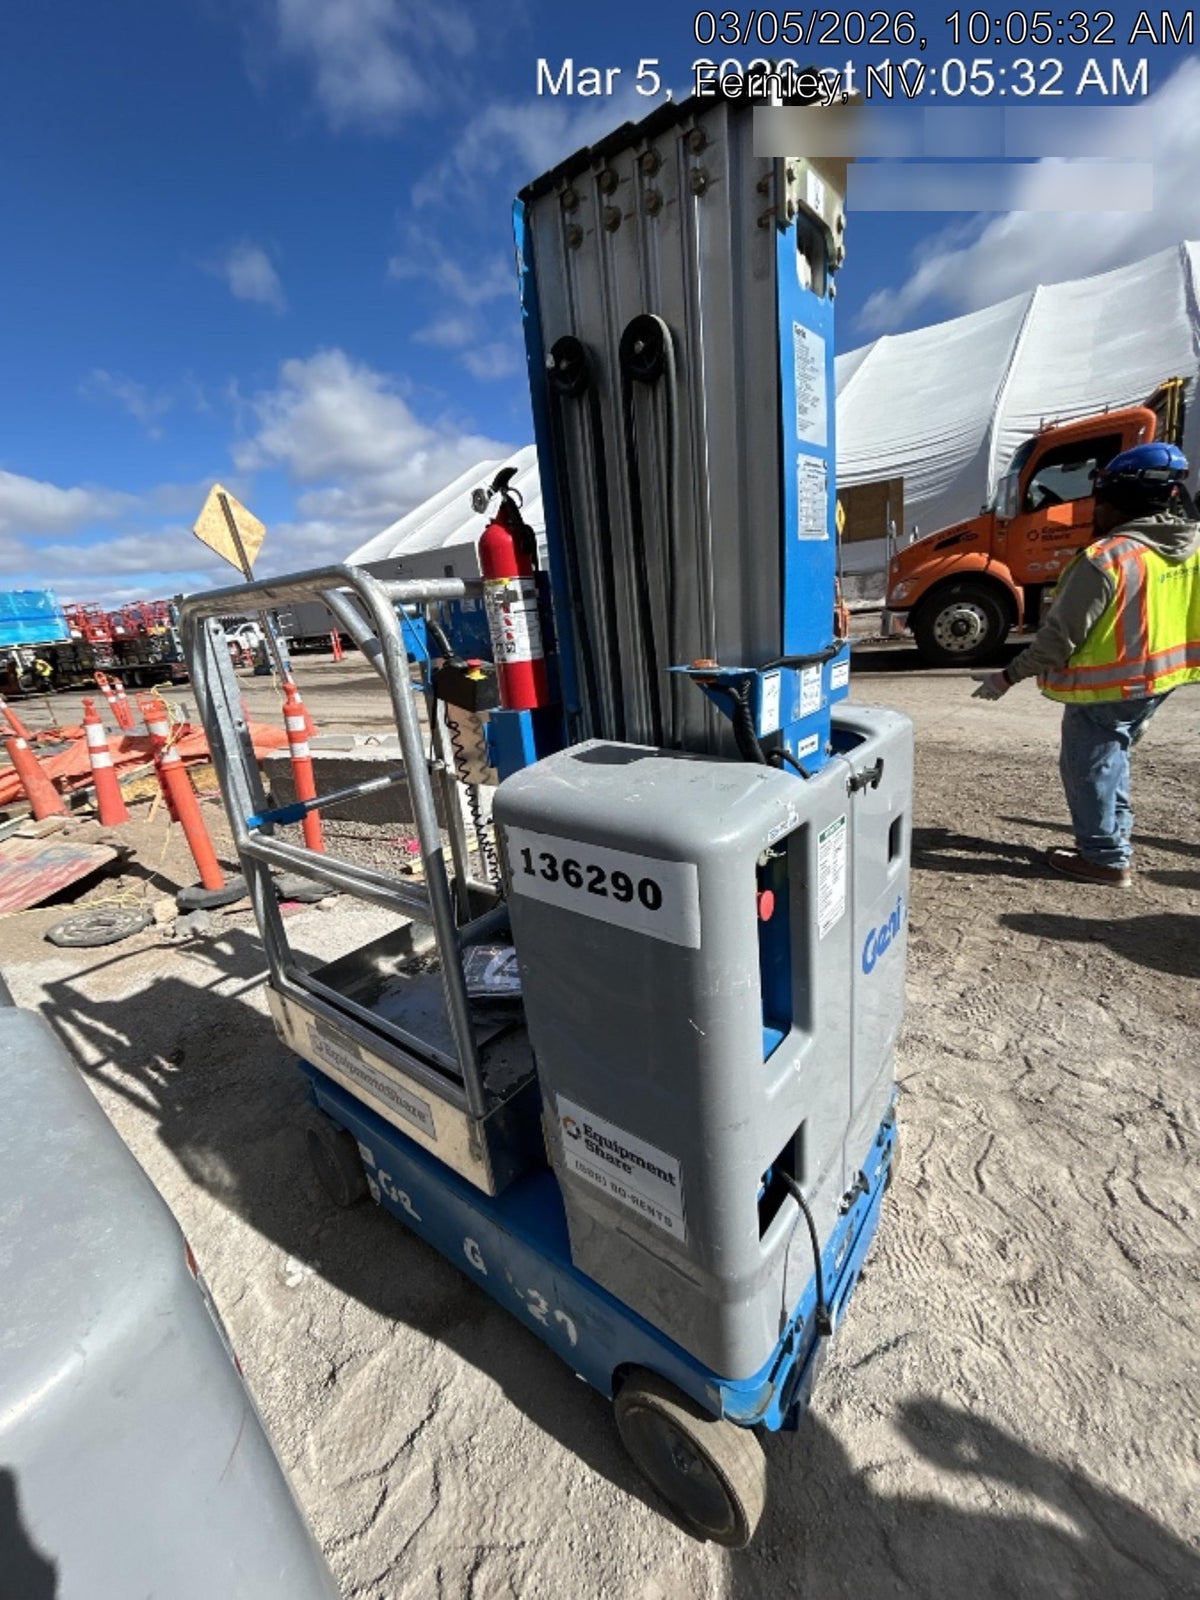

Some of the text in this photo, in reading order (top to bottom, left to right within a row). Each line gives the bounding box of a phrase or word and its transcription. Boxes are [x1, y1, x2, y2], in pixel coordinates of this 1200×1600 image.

[520, 847, 663, 911] 136290
[862, 895, 908, 975] Geni
[583, 1122, 677, 1187] Equipment
[584, 1138, 633, 1175] Share
